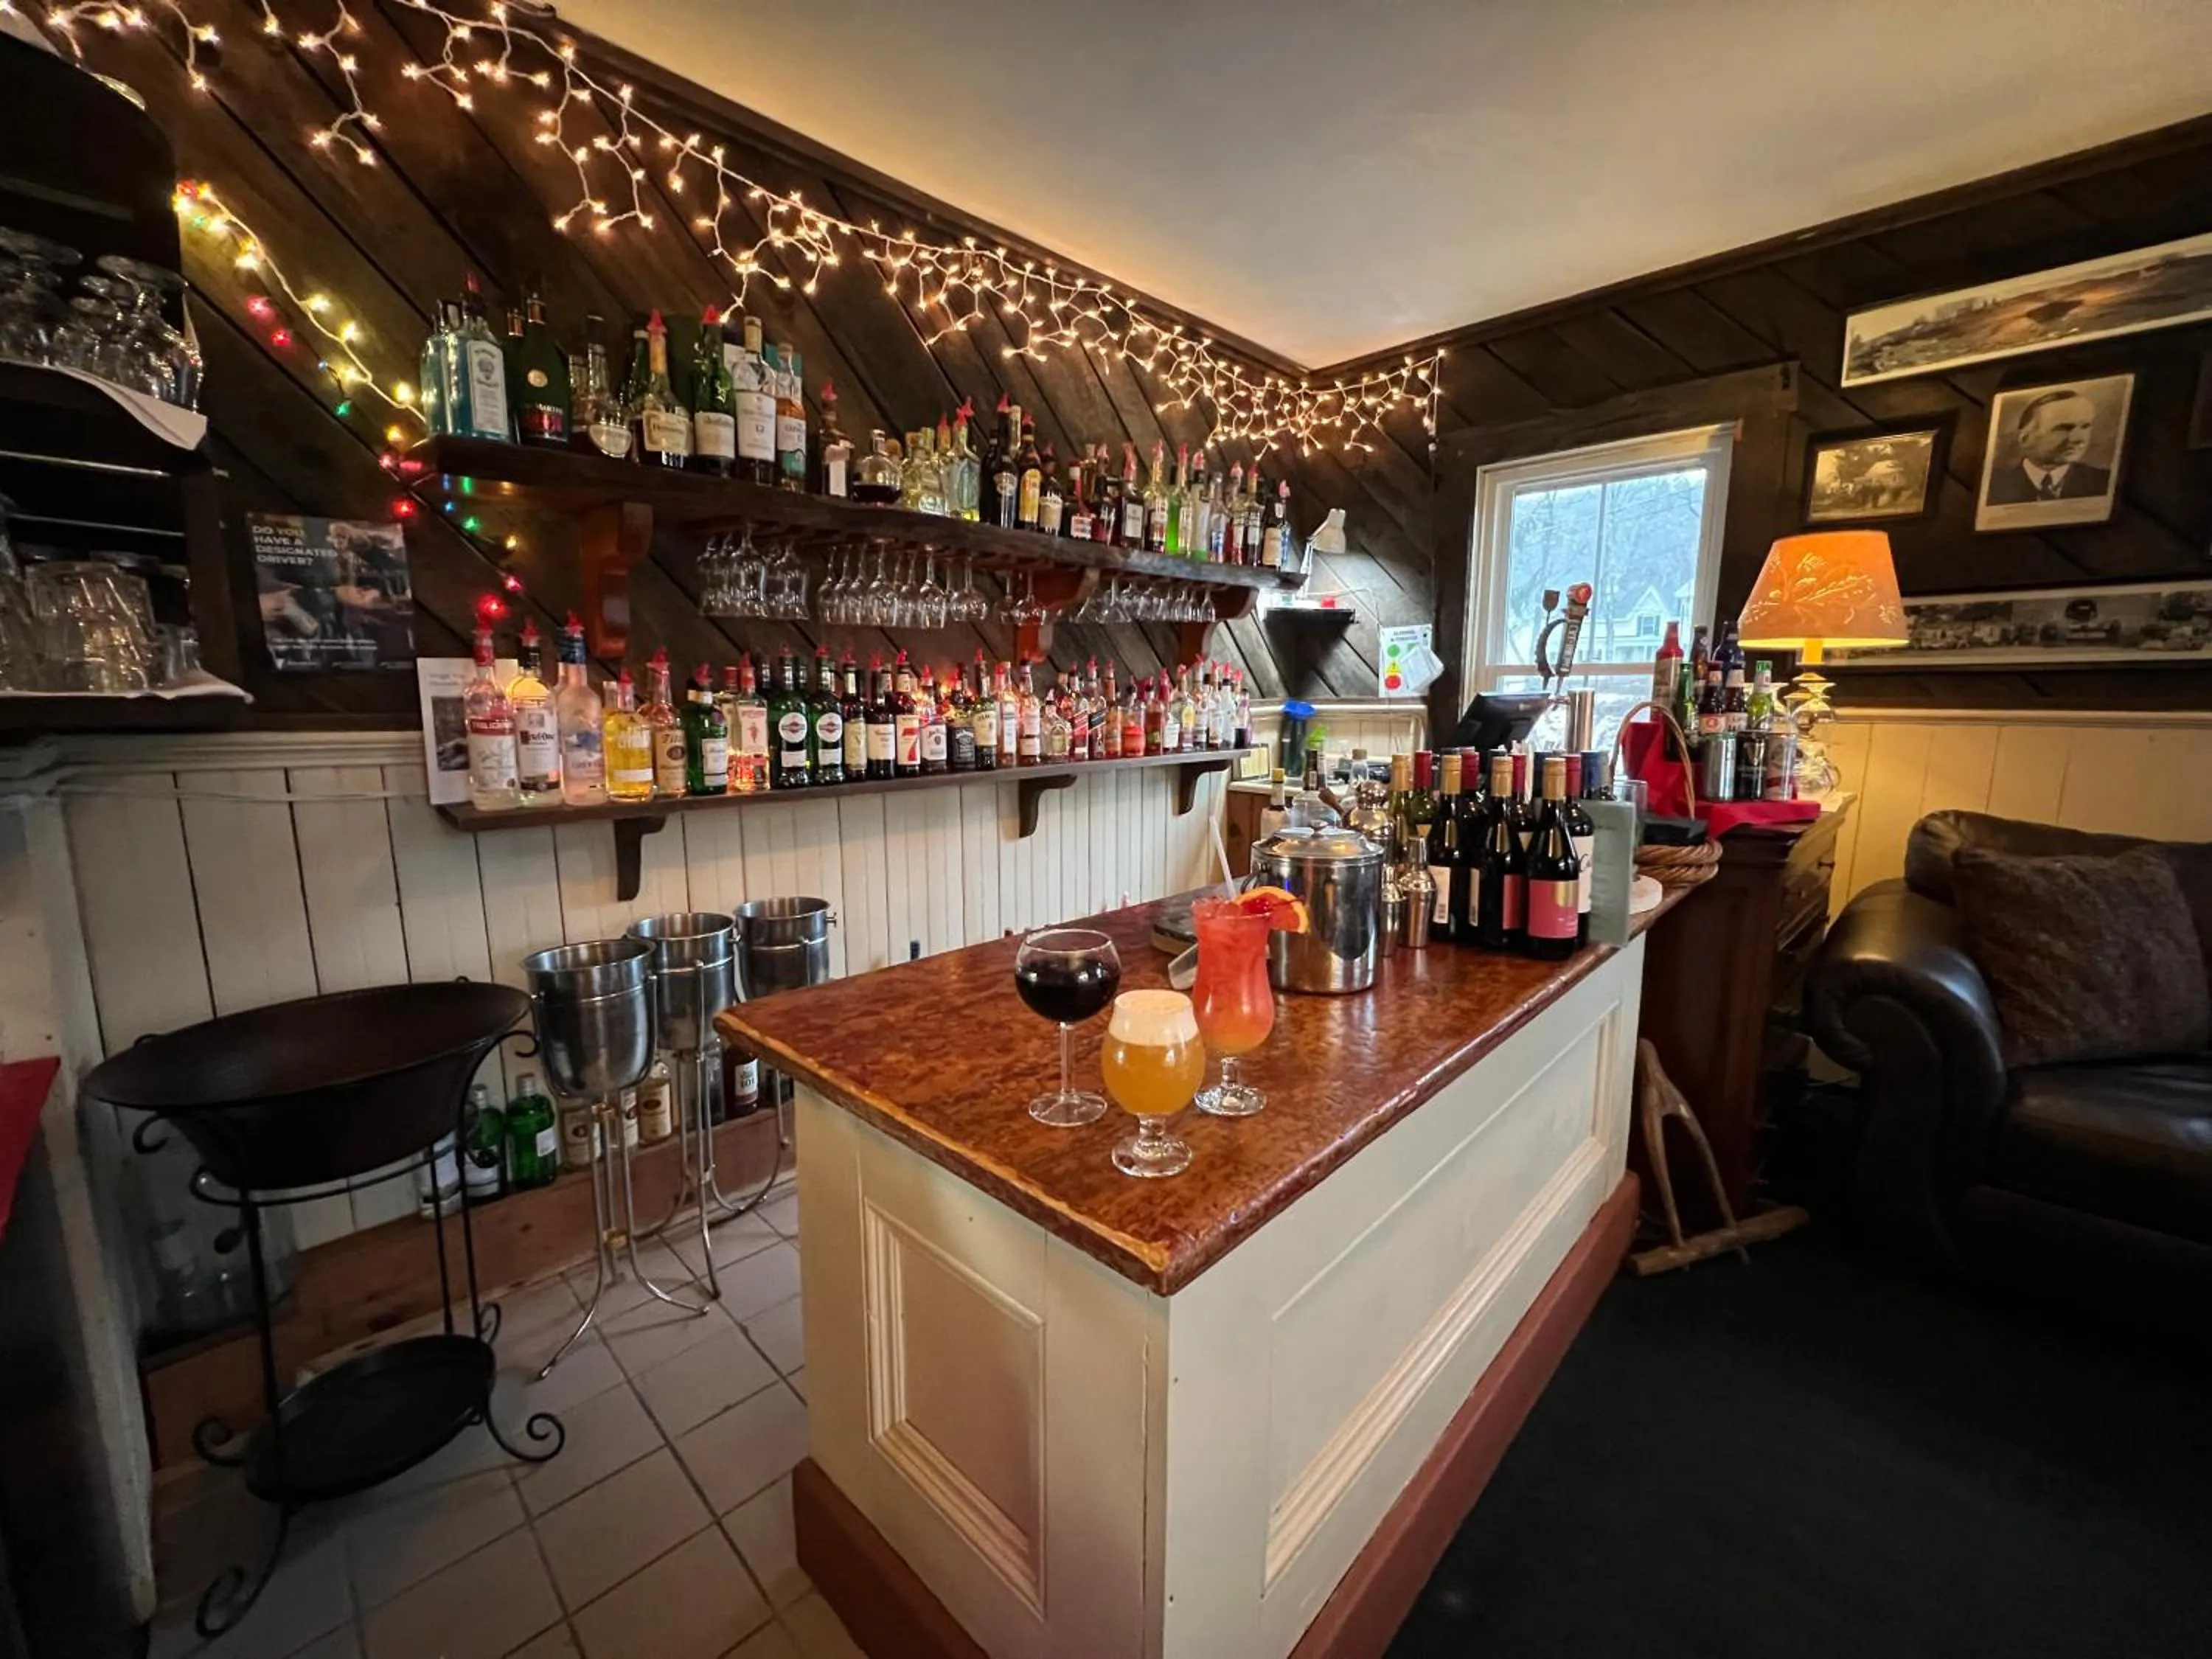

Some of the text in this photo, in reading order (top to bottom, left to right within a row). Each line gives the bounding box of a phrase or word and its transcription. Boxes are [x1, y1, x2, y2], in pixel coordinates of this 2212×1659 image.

[252, 526, 305, 538] DO YOU
[254, 535, 304, 546] HAVE A
[255, 546, 338, 557] DESIGNATED
[257, 554, 314, 566] DRIVER?
